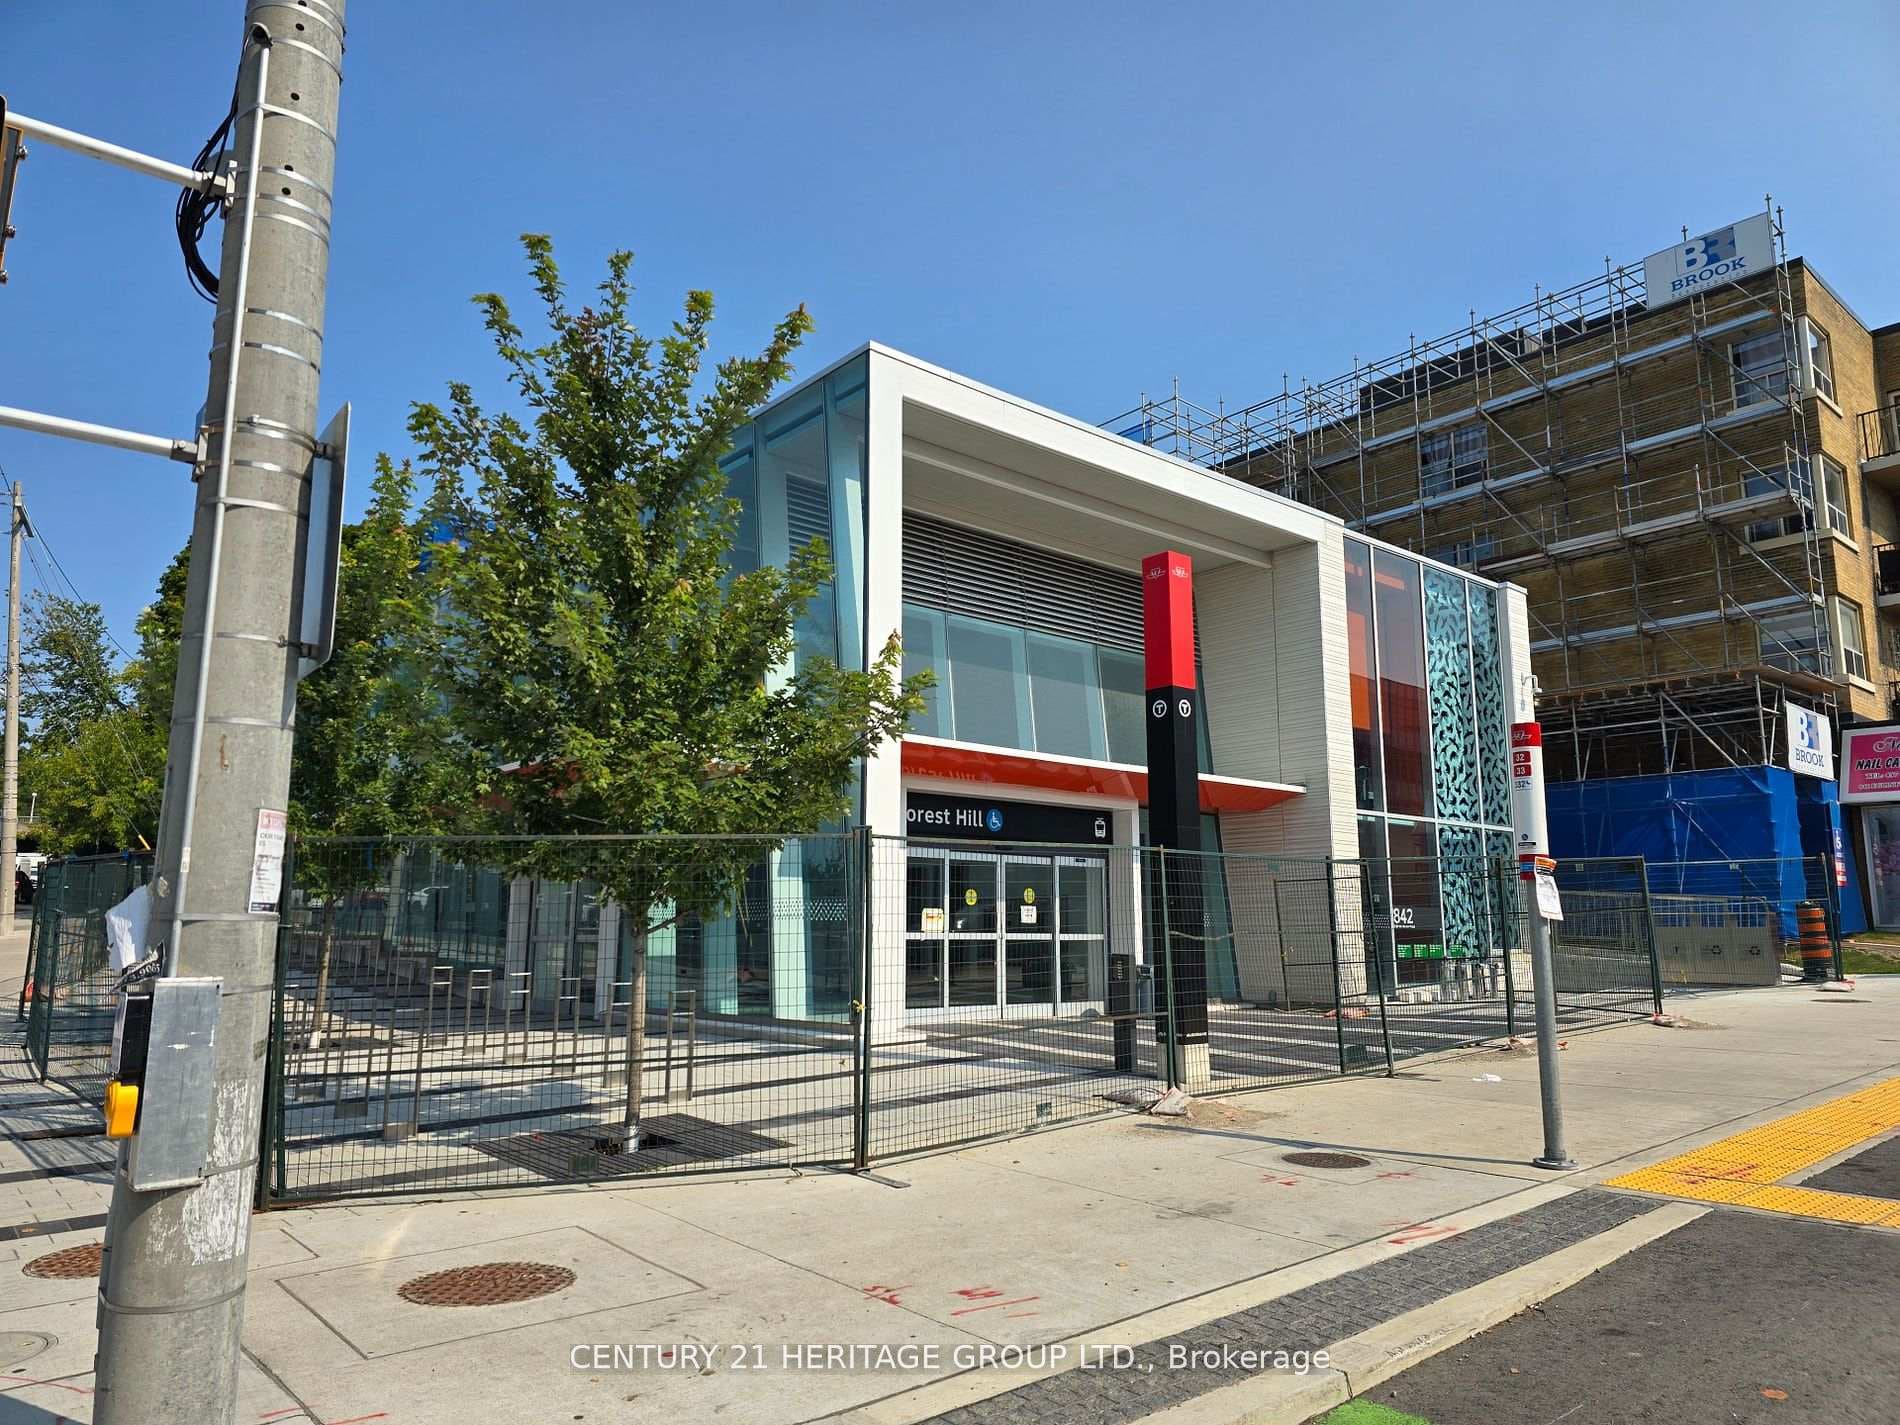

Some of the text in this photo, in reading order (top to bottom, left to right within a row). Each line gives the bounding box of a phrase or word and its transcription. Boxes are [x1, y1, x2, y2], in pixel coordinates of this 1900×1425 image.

[1671, 256, 1746, 292] BROOK
[1515, 753, 1525, 762] 32
[1795, 748, 1825, 767] BROOK
[1856, 759, 1881, 770] NAIL
[906, 808, 984, 827] orest Hill
[1393, 908, 1414, 924] 842
